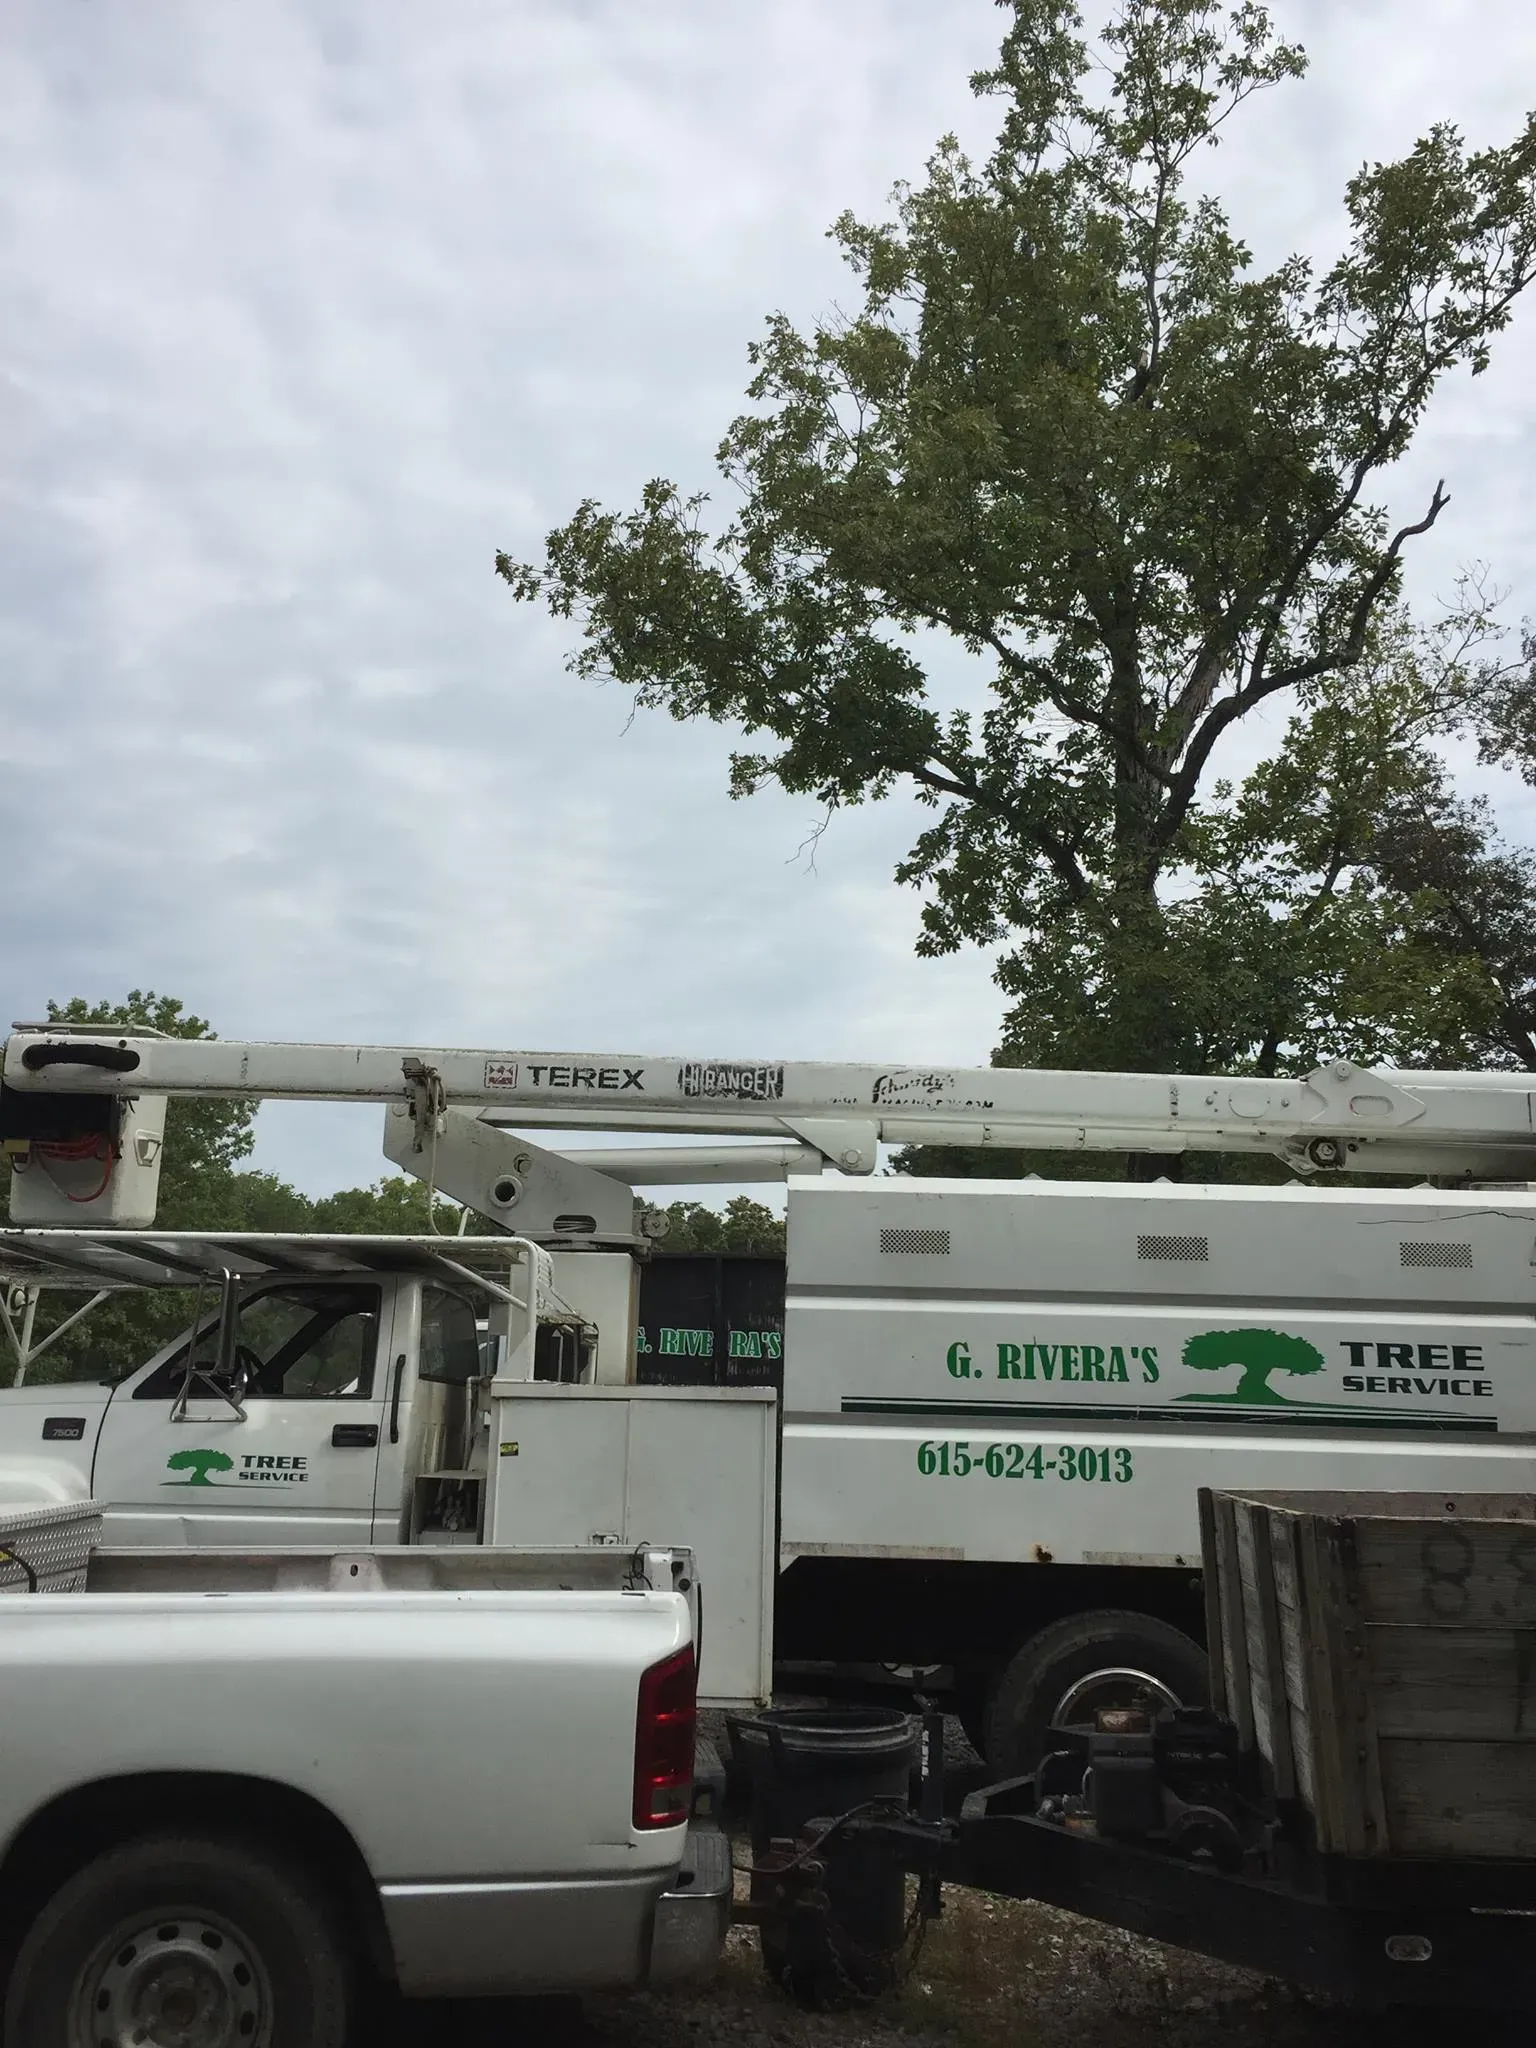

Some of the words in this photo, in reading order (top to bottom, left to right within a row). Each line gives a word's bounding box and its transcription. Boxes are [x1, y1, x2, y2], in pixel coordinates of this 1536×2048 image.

[527, 1065, 645, 1090] TEREX
[946, 1342, 983, 1379] G.
[996, 1343, 1160, 1383] RIVERA'S
[1340, 1341, 1485, 1371] TREE
[1342, 1376, 1494, 1396] SERVICE
[241, 1455, 307, 1470] TREE
[917, 1440, 1134, 1483] 615-624-3013
[238, 1471, 309, 1482] SERVICE
